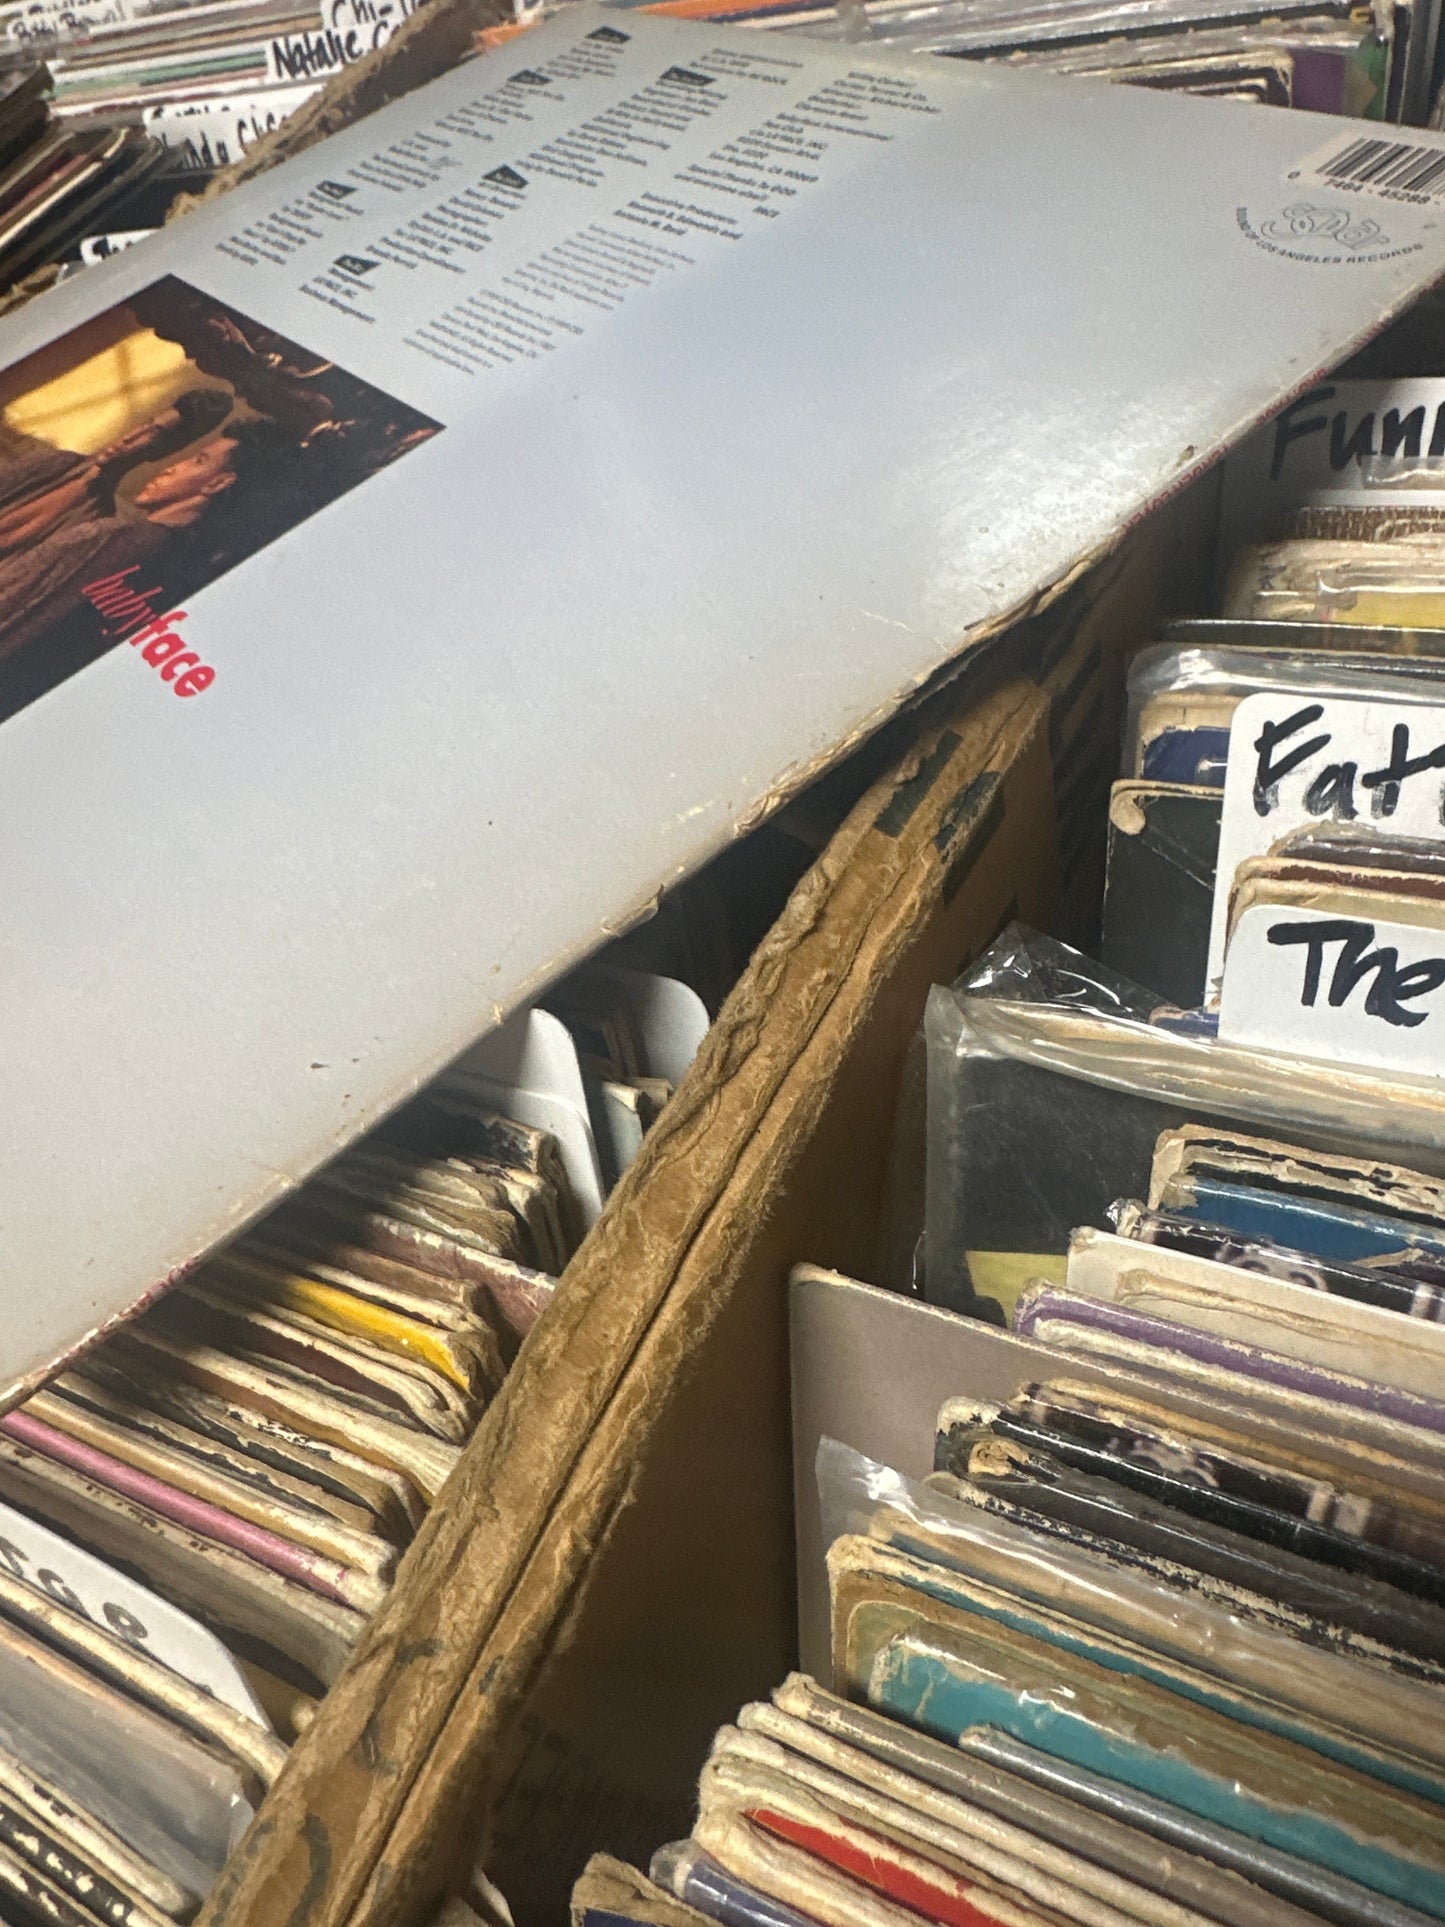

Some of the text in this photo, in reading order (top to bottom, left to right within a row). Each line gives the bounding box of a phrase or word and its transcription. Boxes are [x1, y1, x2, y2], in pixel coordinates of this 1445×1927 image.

[272, 30, 363, 78] Natalie
[1345, 242, 1425, 265] RECORDS
[1269, 385, 1445, 481] Fun
[81, 563, 216, 698] babyface
[1267, 919, 1445, 1027] The
